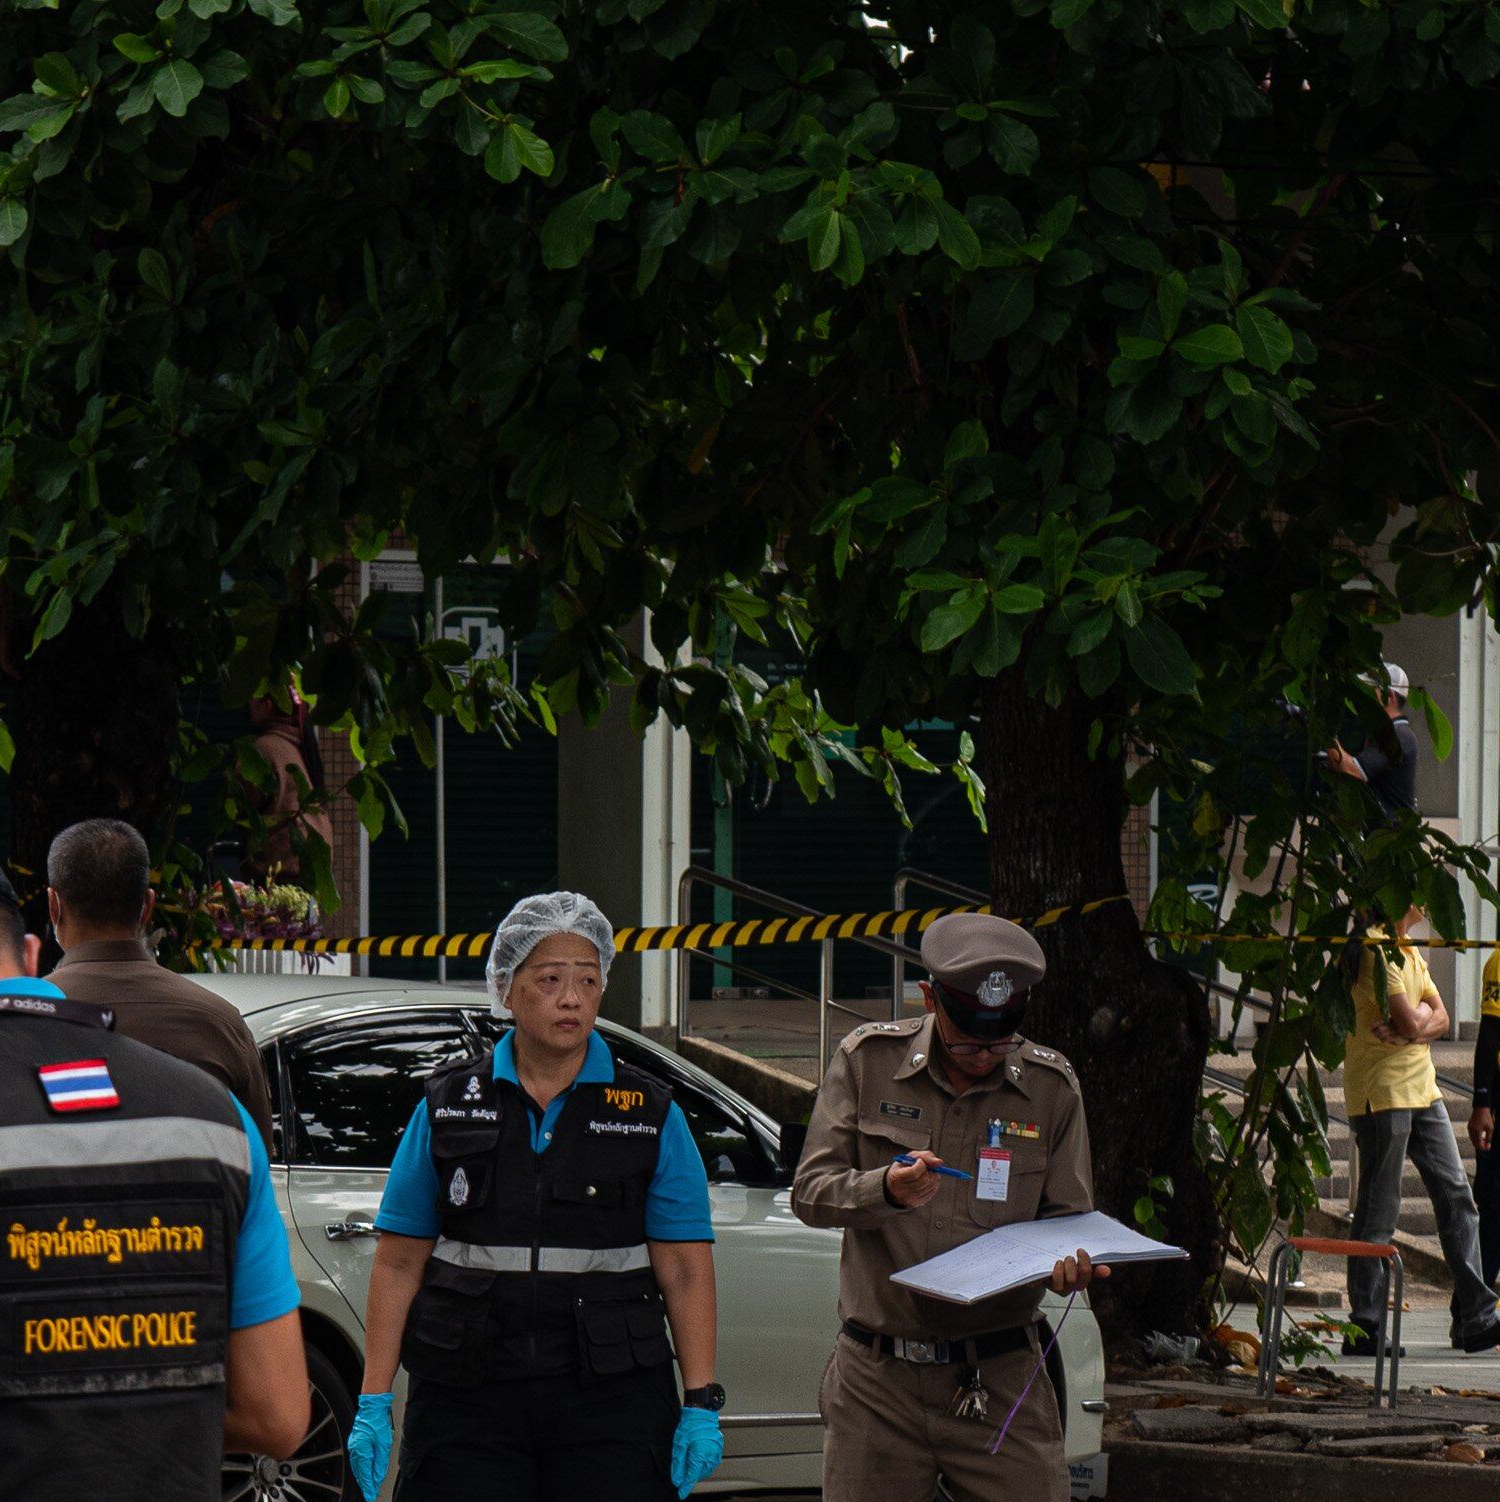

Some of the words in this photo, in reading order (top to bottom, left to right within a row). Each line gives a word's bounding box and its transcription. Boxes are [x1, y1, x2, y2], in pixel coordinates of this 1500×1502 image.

[13, 999, 56, 1013] adidas
[604, 1088, 644, 1111] พฐก
[7, 1216, 205, 1271] พิสูจน์หลักฐานตำรวจ
[24, 1315, 131, 1354] FORENSIC
[132, 1311, 197, 1348] POLICE
